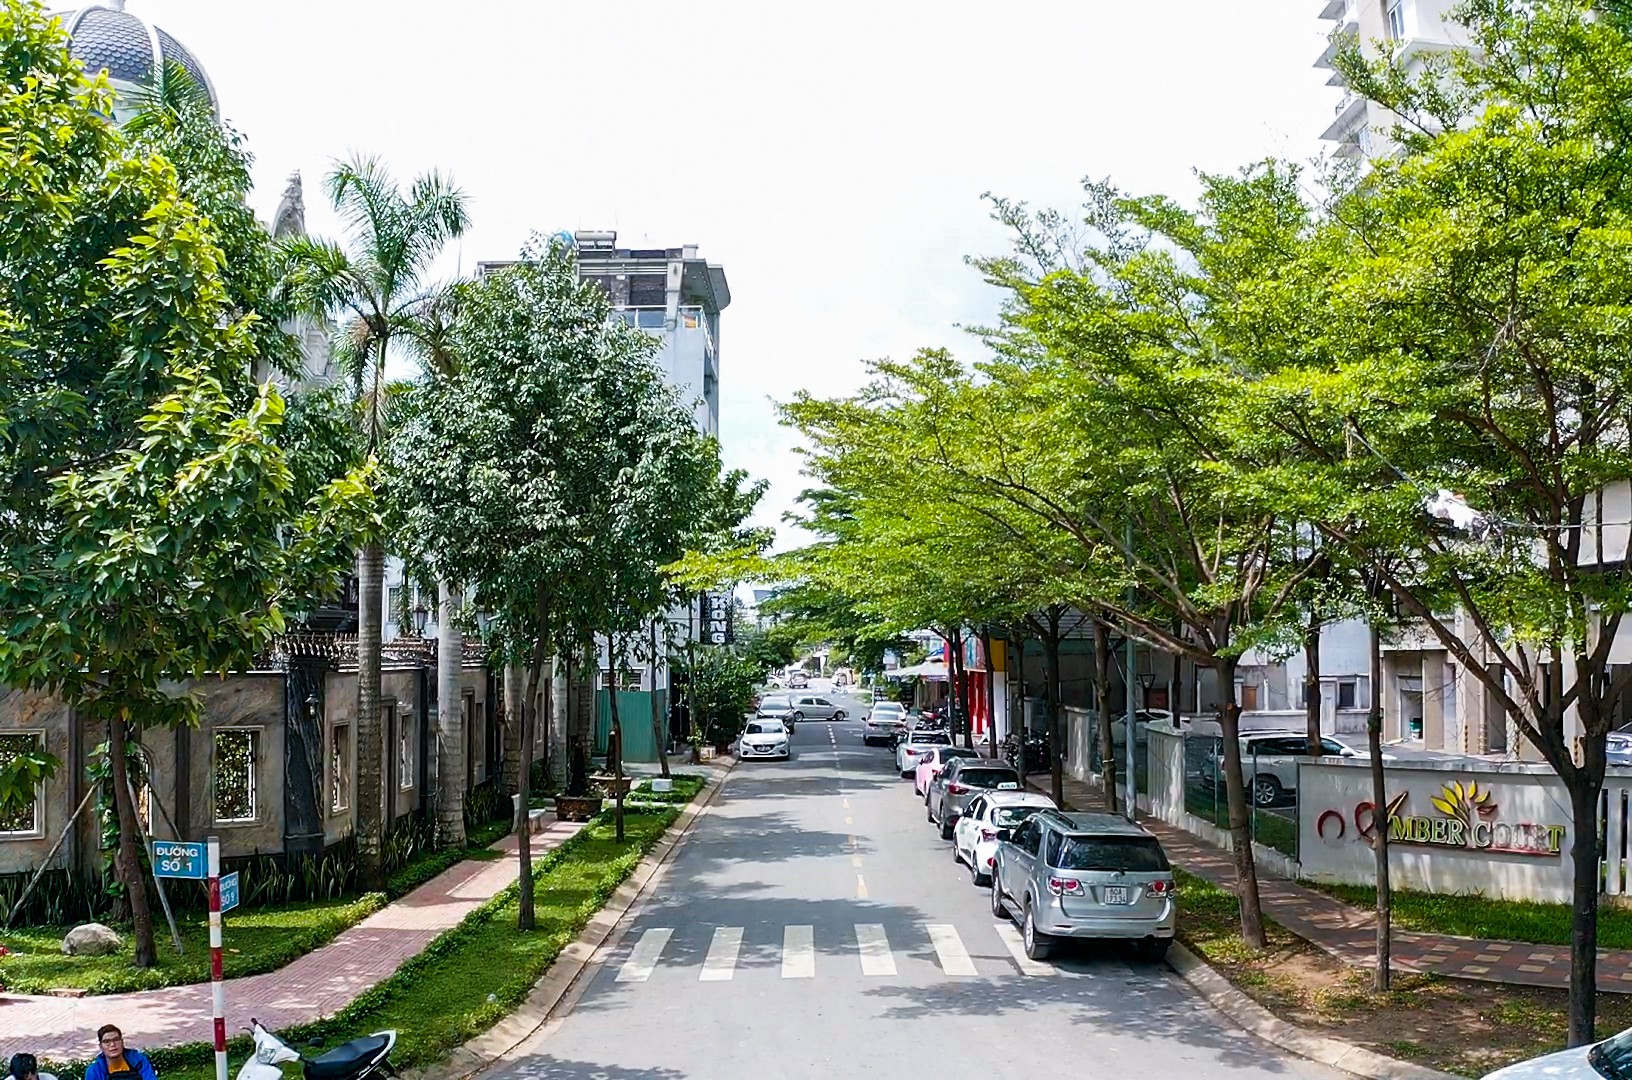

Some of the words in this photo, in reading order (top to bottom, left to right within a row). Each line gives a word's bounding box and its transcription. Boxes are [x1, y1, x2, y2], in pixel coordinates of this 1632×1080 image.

[1471, 820, 1566, 852] COURT
[156, 846, 198, 857] ĐƯỜNG
[161, 857, 181, 872] SỐ
[186, 862, 193, 872] 1
